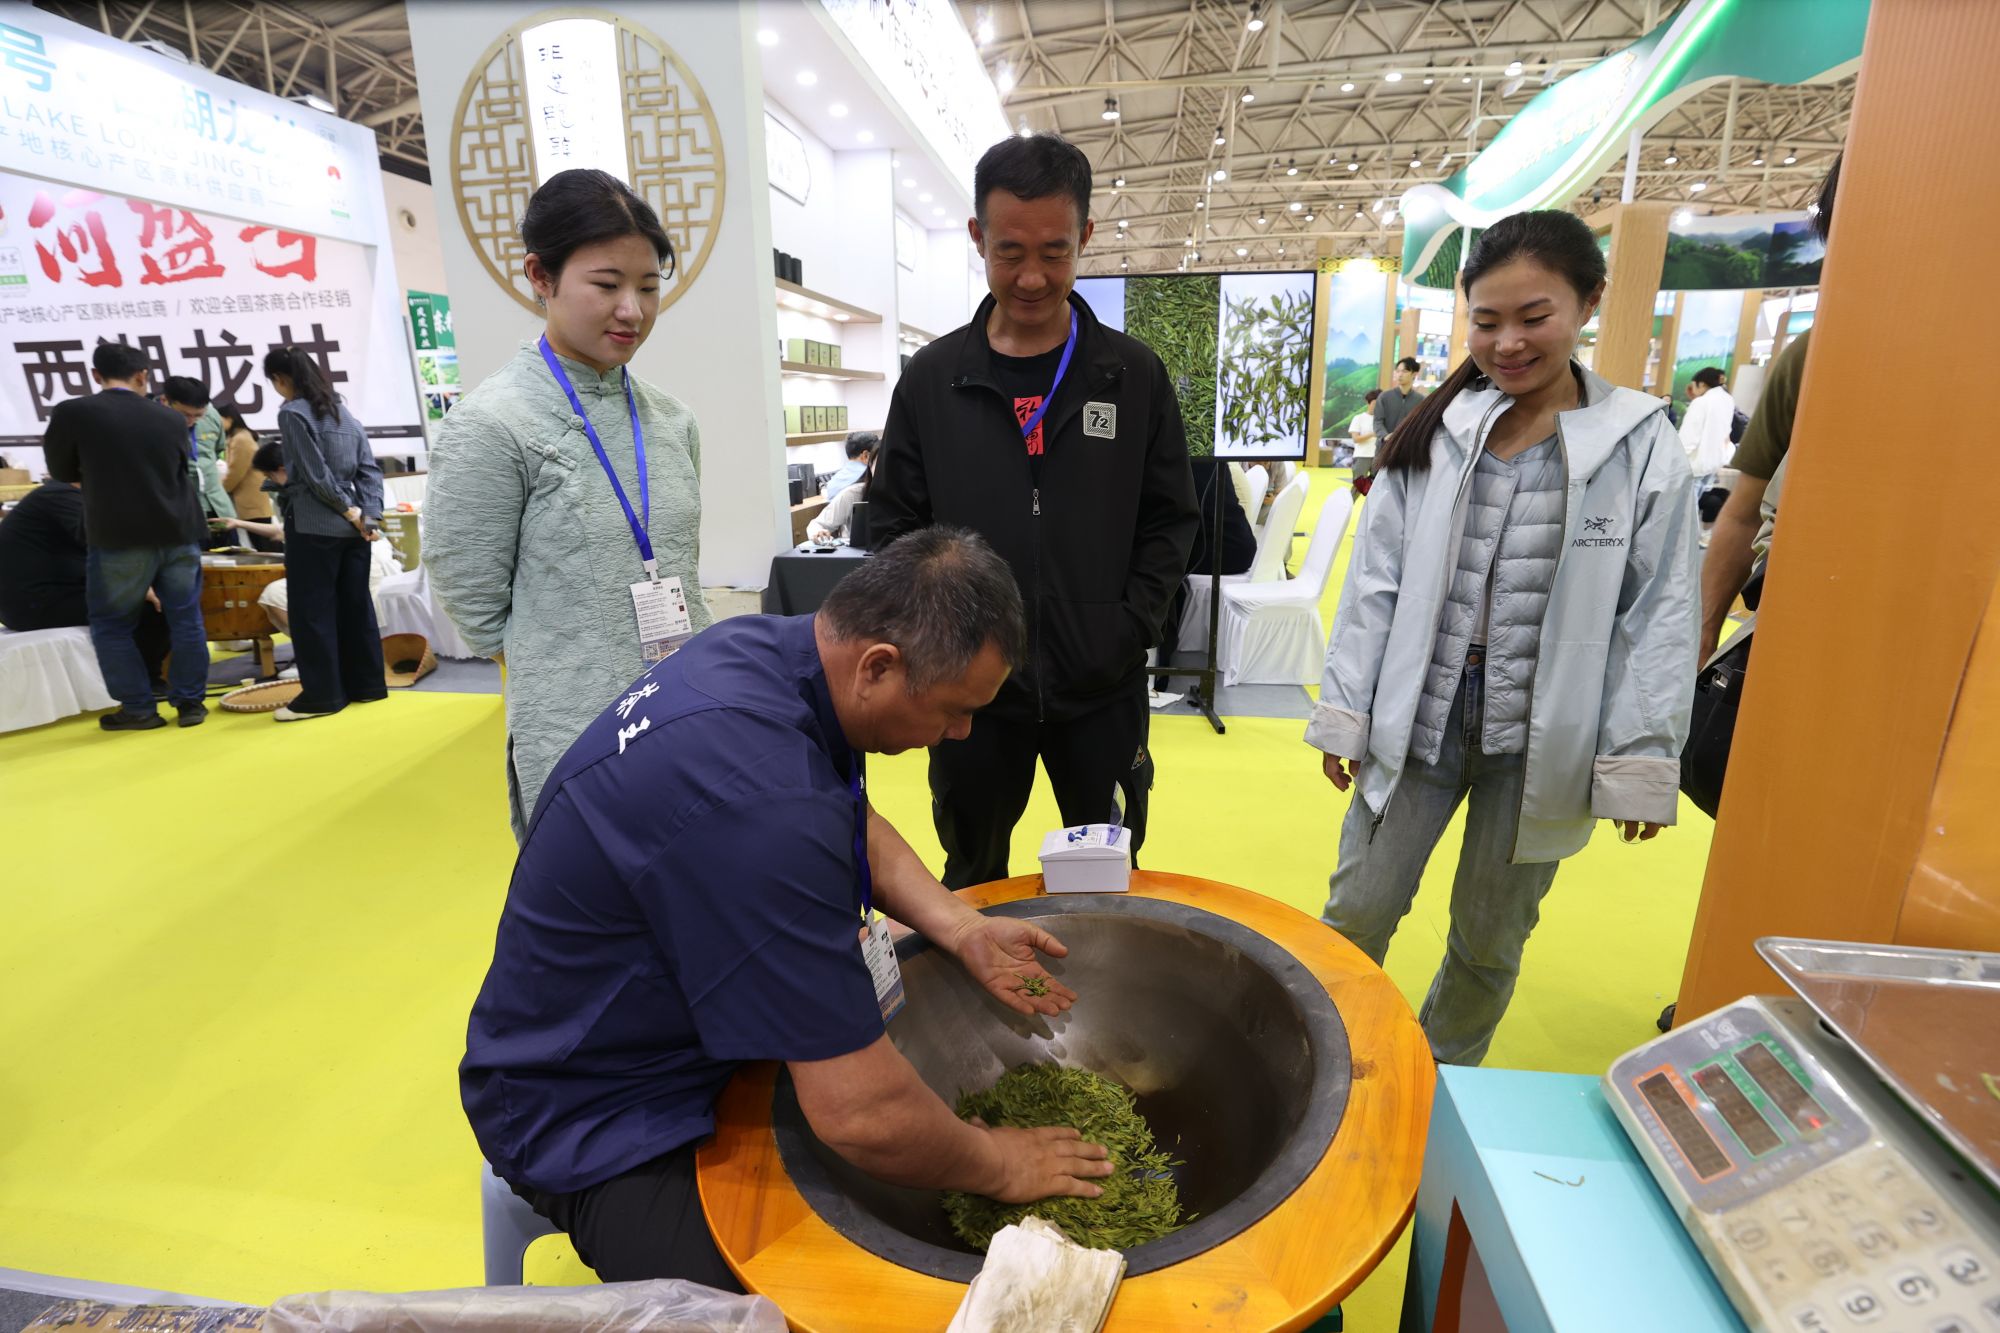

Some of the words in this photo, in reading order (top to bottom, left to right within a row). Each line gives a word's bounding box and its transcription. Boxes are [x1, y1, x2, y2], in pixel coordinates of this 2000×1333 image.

[3, 96, 88, 137] LAKE
[191, 150, 245, 178] JING
[189, 289, 352, 315] 欢迎全国茶商合作经销
[1846, 1294, 1876, 1316] 9
